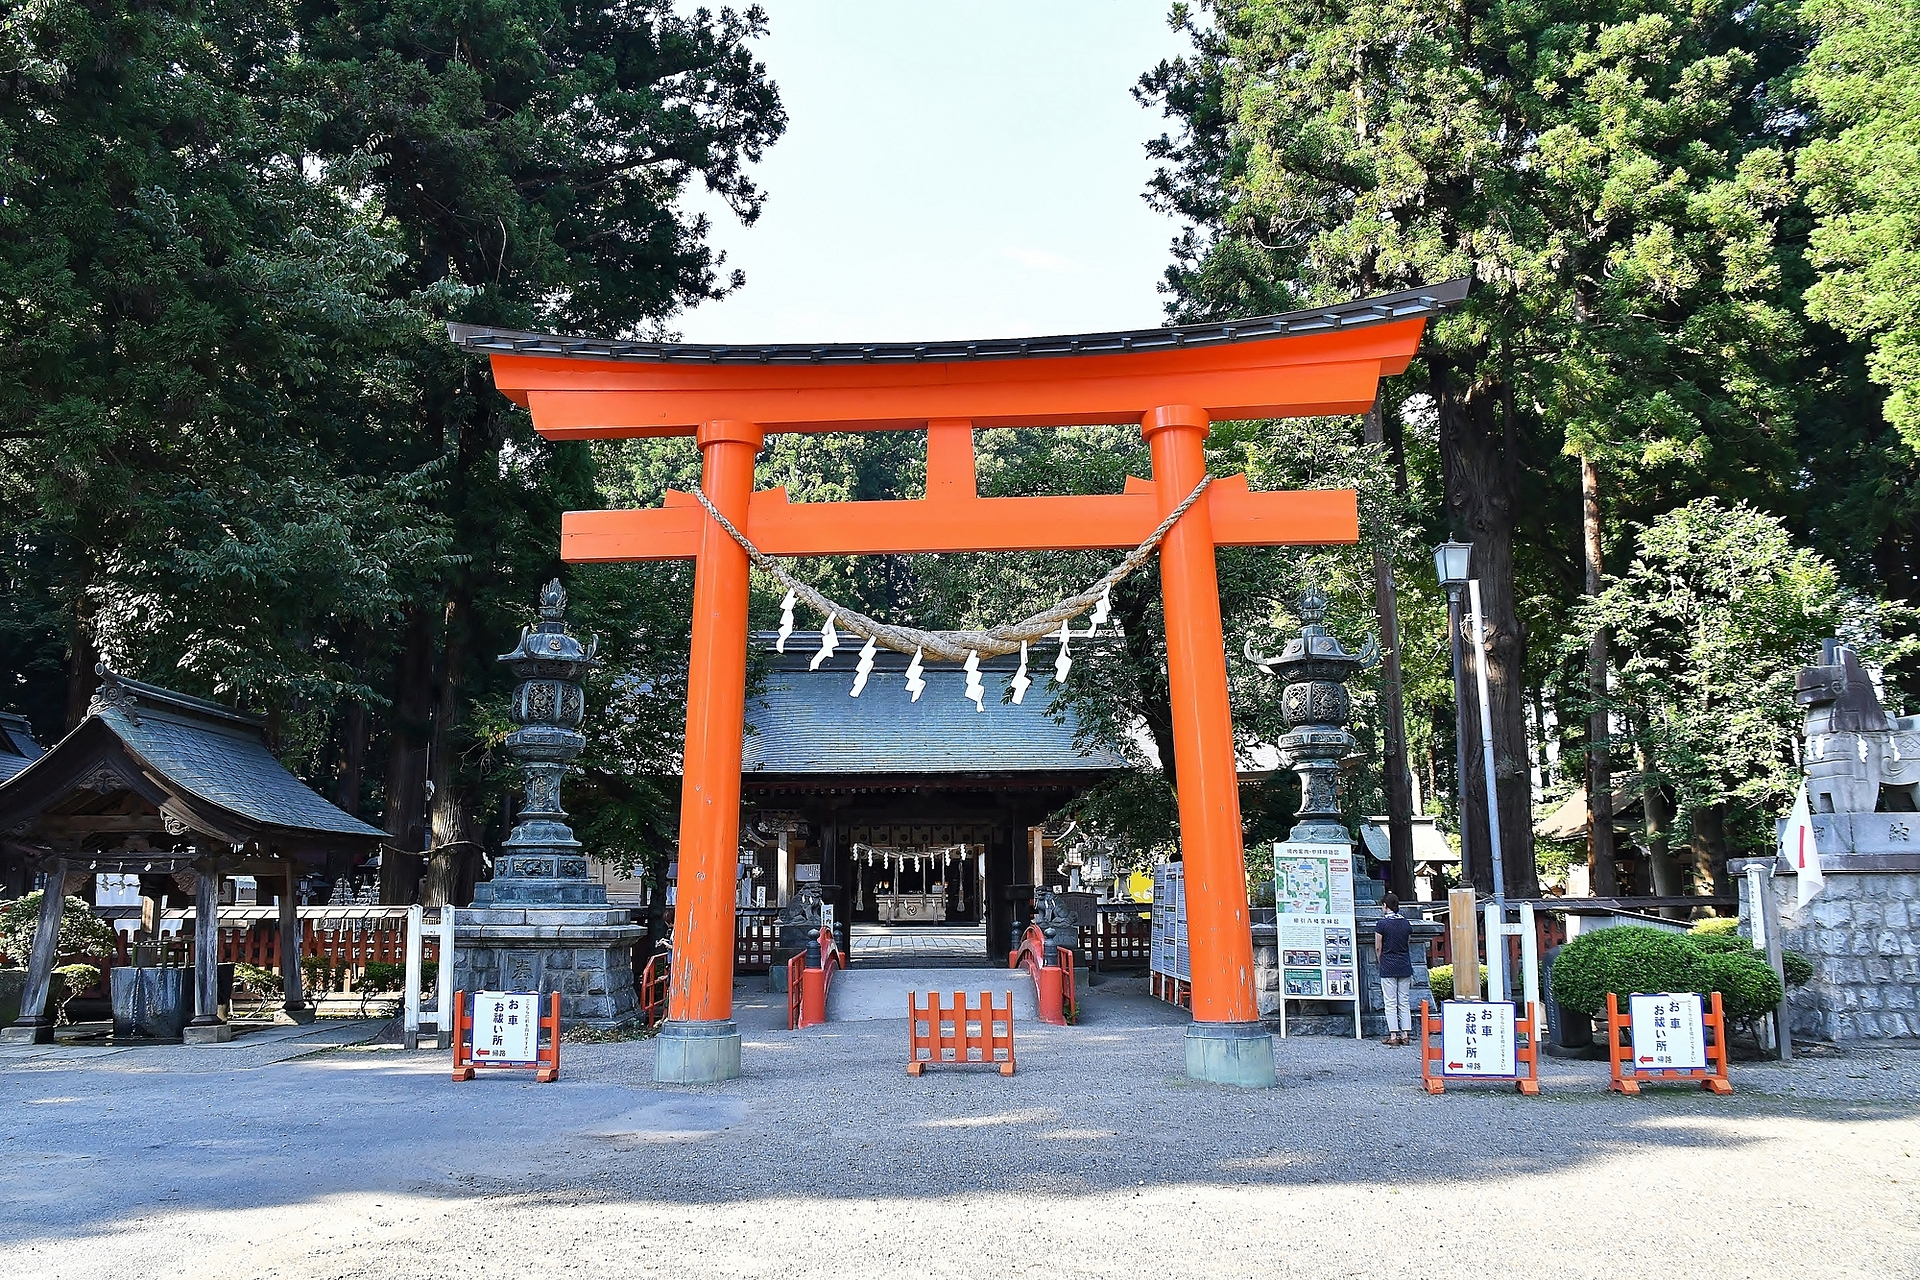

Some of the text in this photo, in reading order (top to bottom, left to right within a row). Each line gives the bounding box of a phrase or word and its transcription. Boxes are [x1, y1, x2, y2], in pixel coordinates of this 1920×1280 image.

[492, 1002, 504, 1047] お祓い所
[508, 999, 519, 1026] お車
[1481, 1009, 1493, 1037] お車
[1654, 1005, 1667, 1052] お祓い所
[1669, 1001, 1681, 1029] お車
[1465, 1012, 1477, 1058] お祓い所
